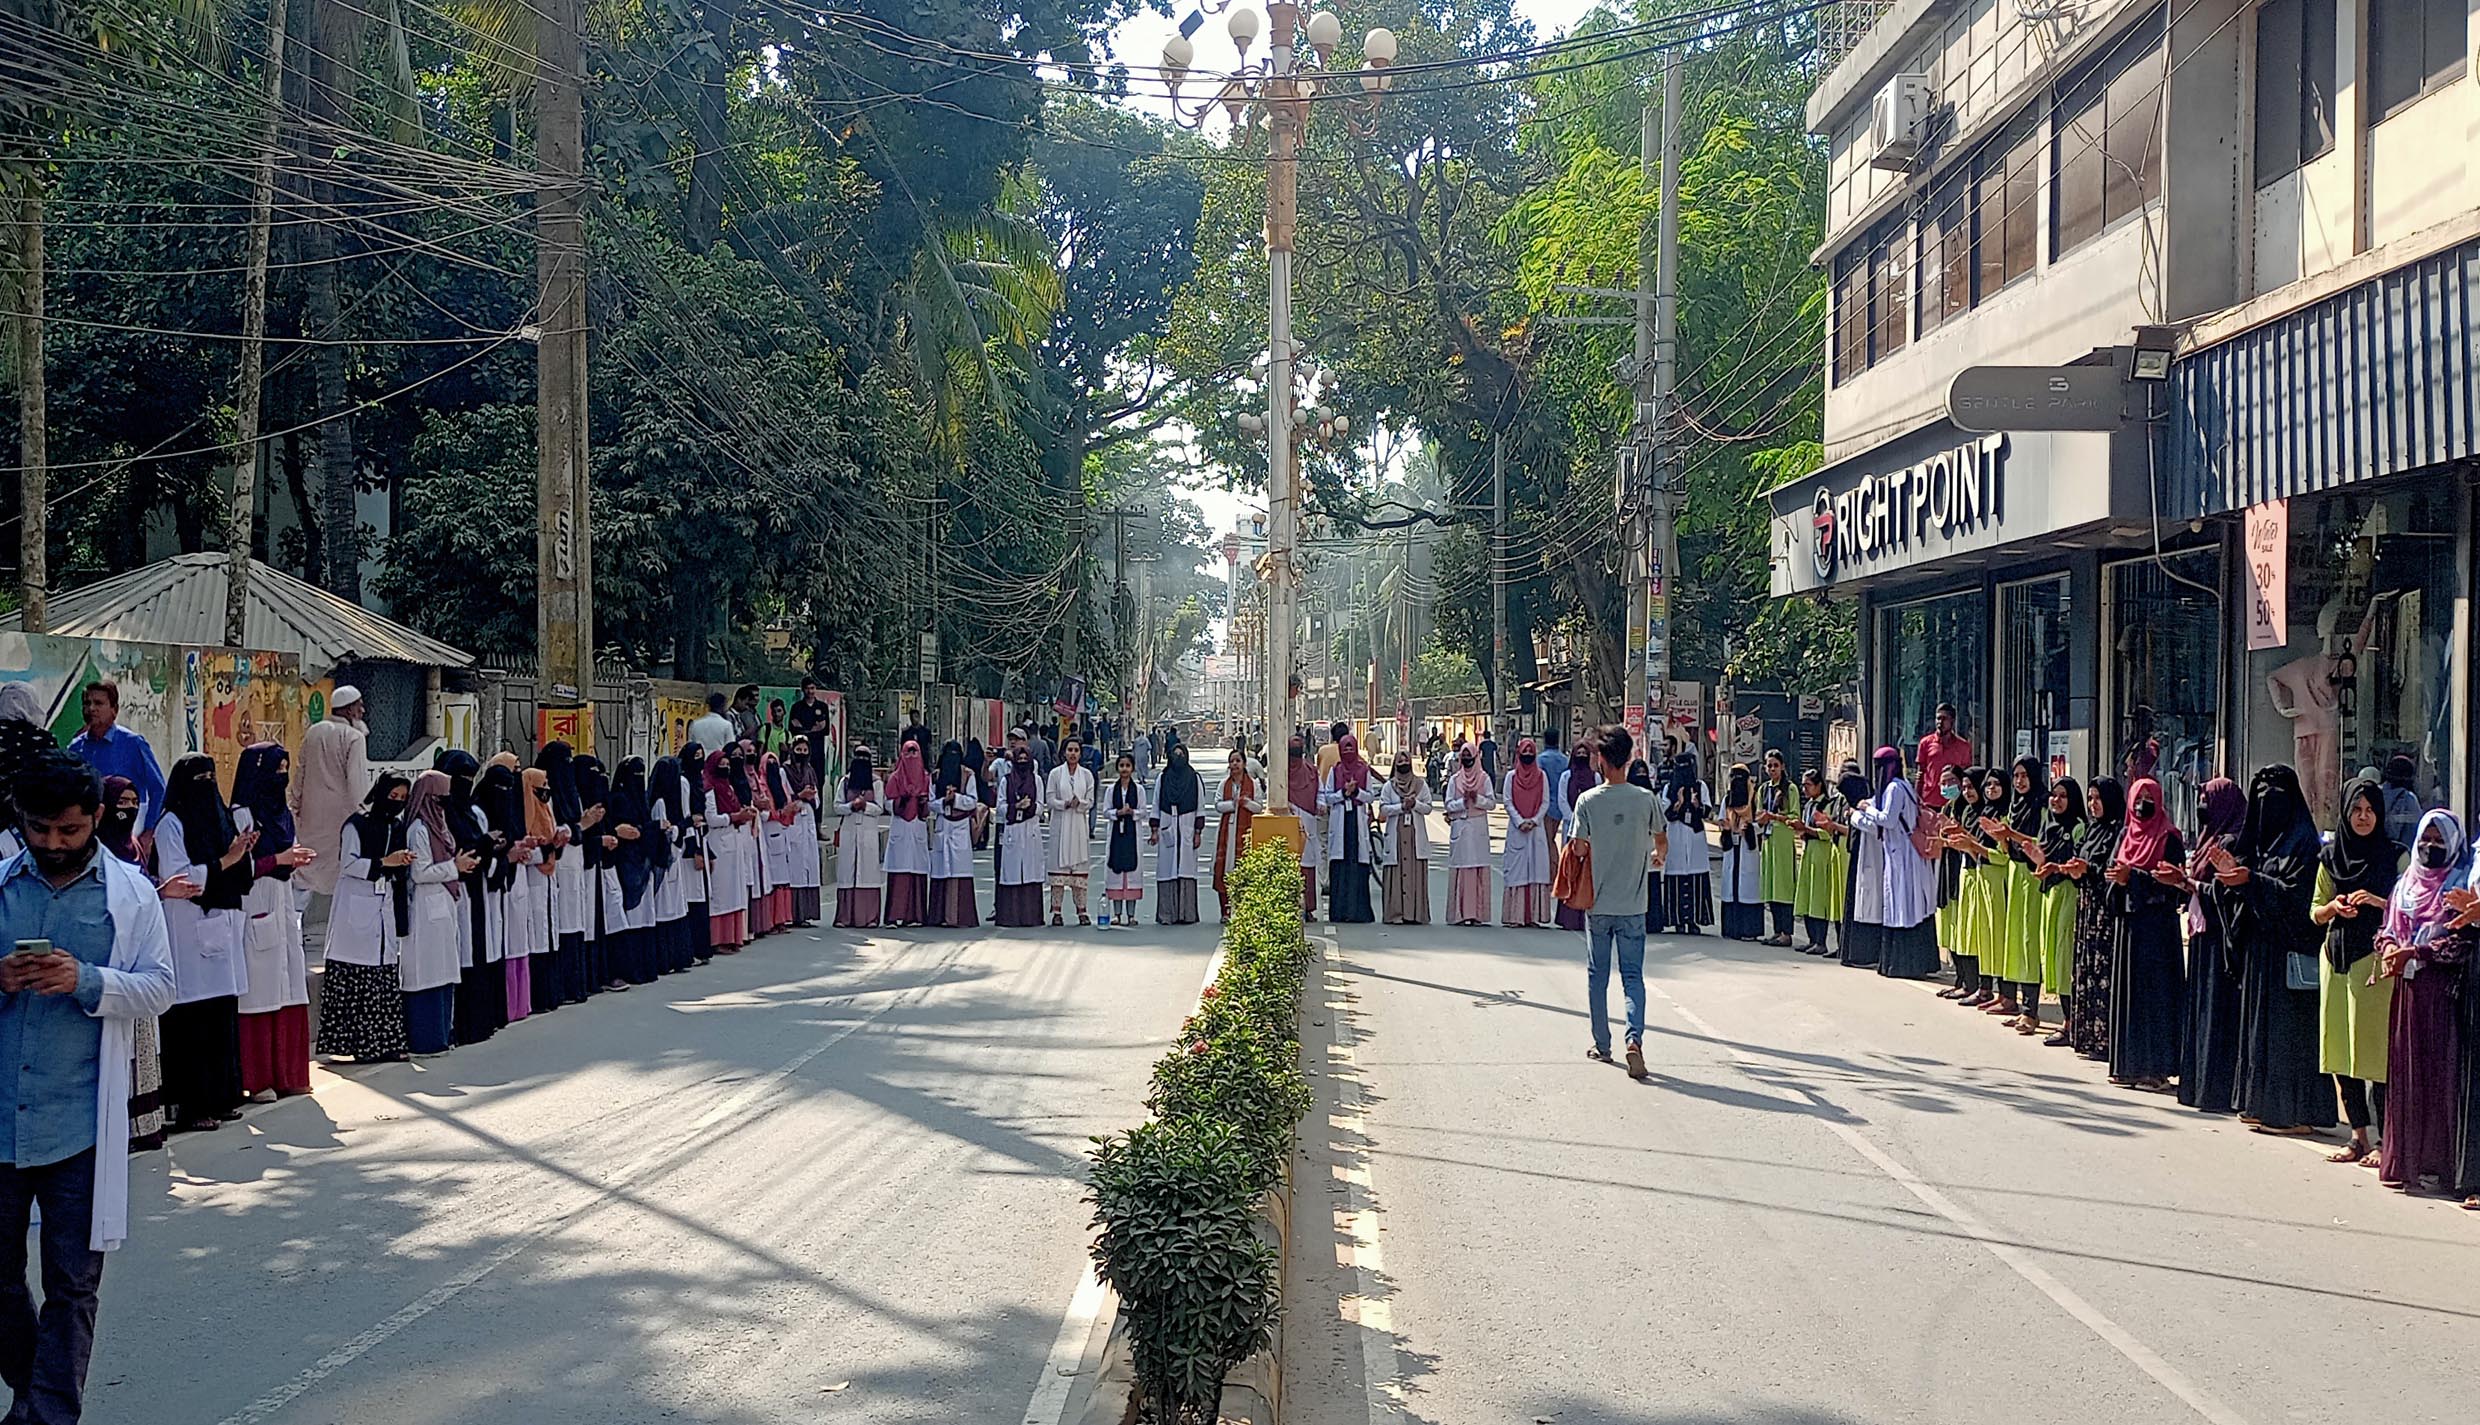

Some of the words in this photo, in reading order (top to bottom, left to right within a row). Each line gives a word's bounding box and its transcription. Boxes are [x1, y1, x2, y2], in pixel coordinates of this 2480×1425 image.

[1958, 396, 2036, 409] GENTLE
[1836, 470, 1906, 560] RIGHT
[1912, 431, 2002, 537] POINT
[2261, 544, 2273, 553] SALE
